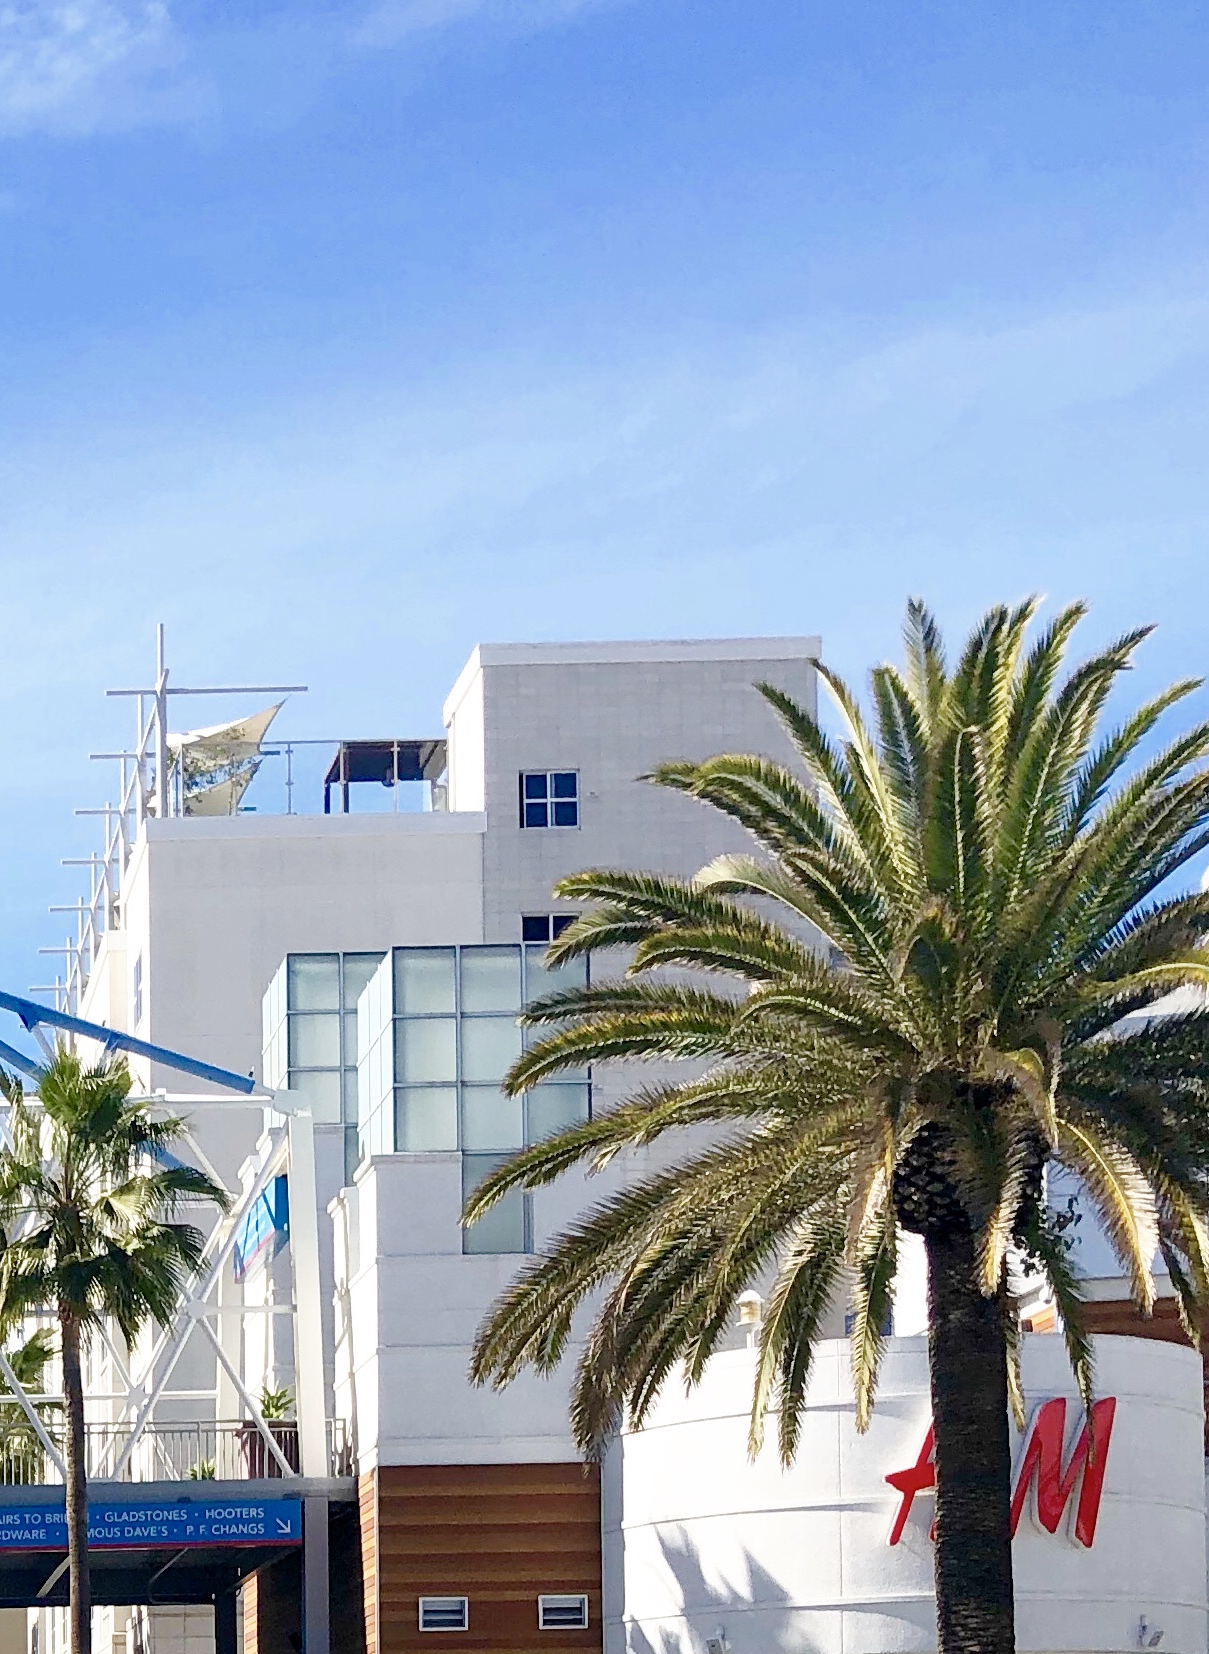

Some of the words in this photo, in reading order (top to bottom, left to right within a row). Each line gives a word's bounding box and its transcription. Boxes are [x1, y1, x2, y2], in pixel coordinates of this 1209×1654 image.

[24, 1513, 42, 1525] TO
[104, 1509, 188, 1523] GLADSTONES
[205, 1507, 265, 1519] HOOTERS
[124, 1525, 169, 1537] DAVE'S
[211, 1523, 265, 1535] CHANGS
